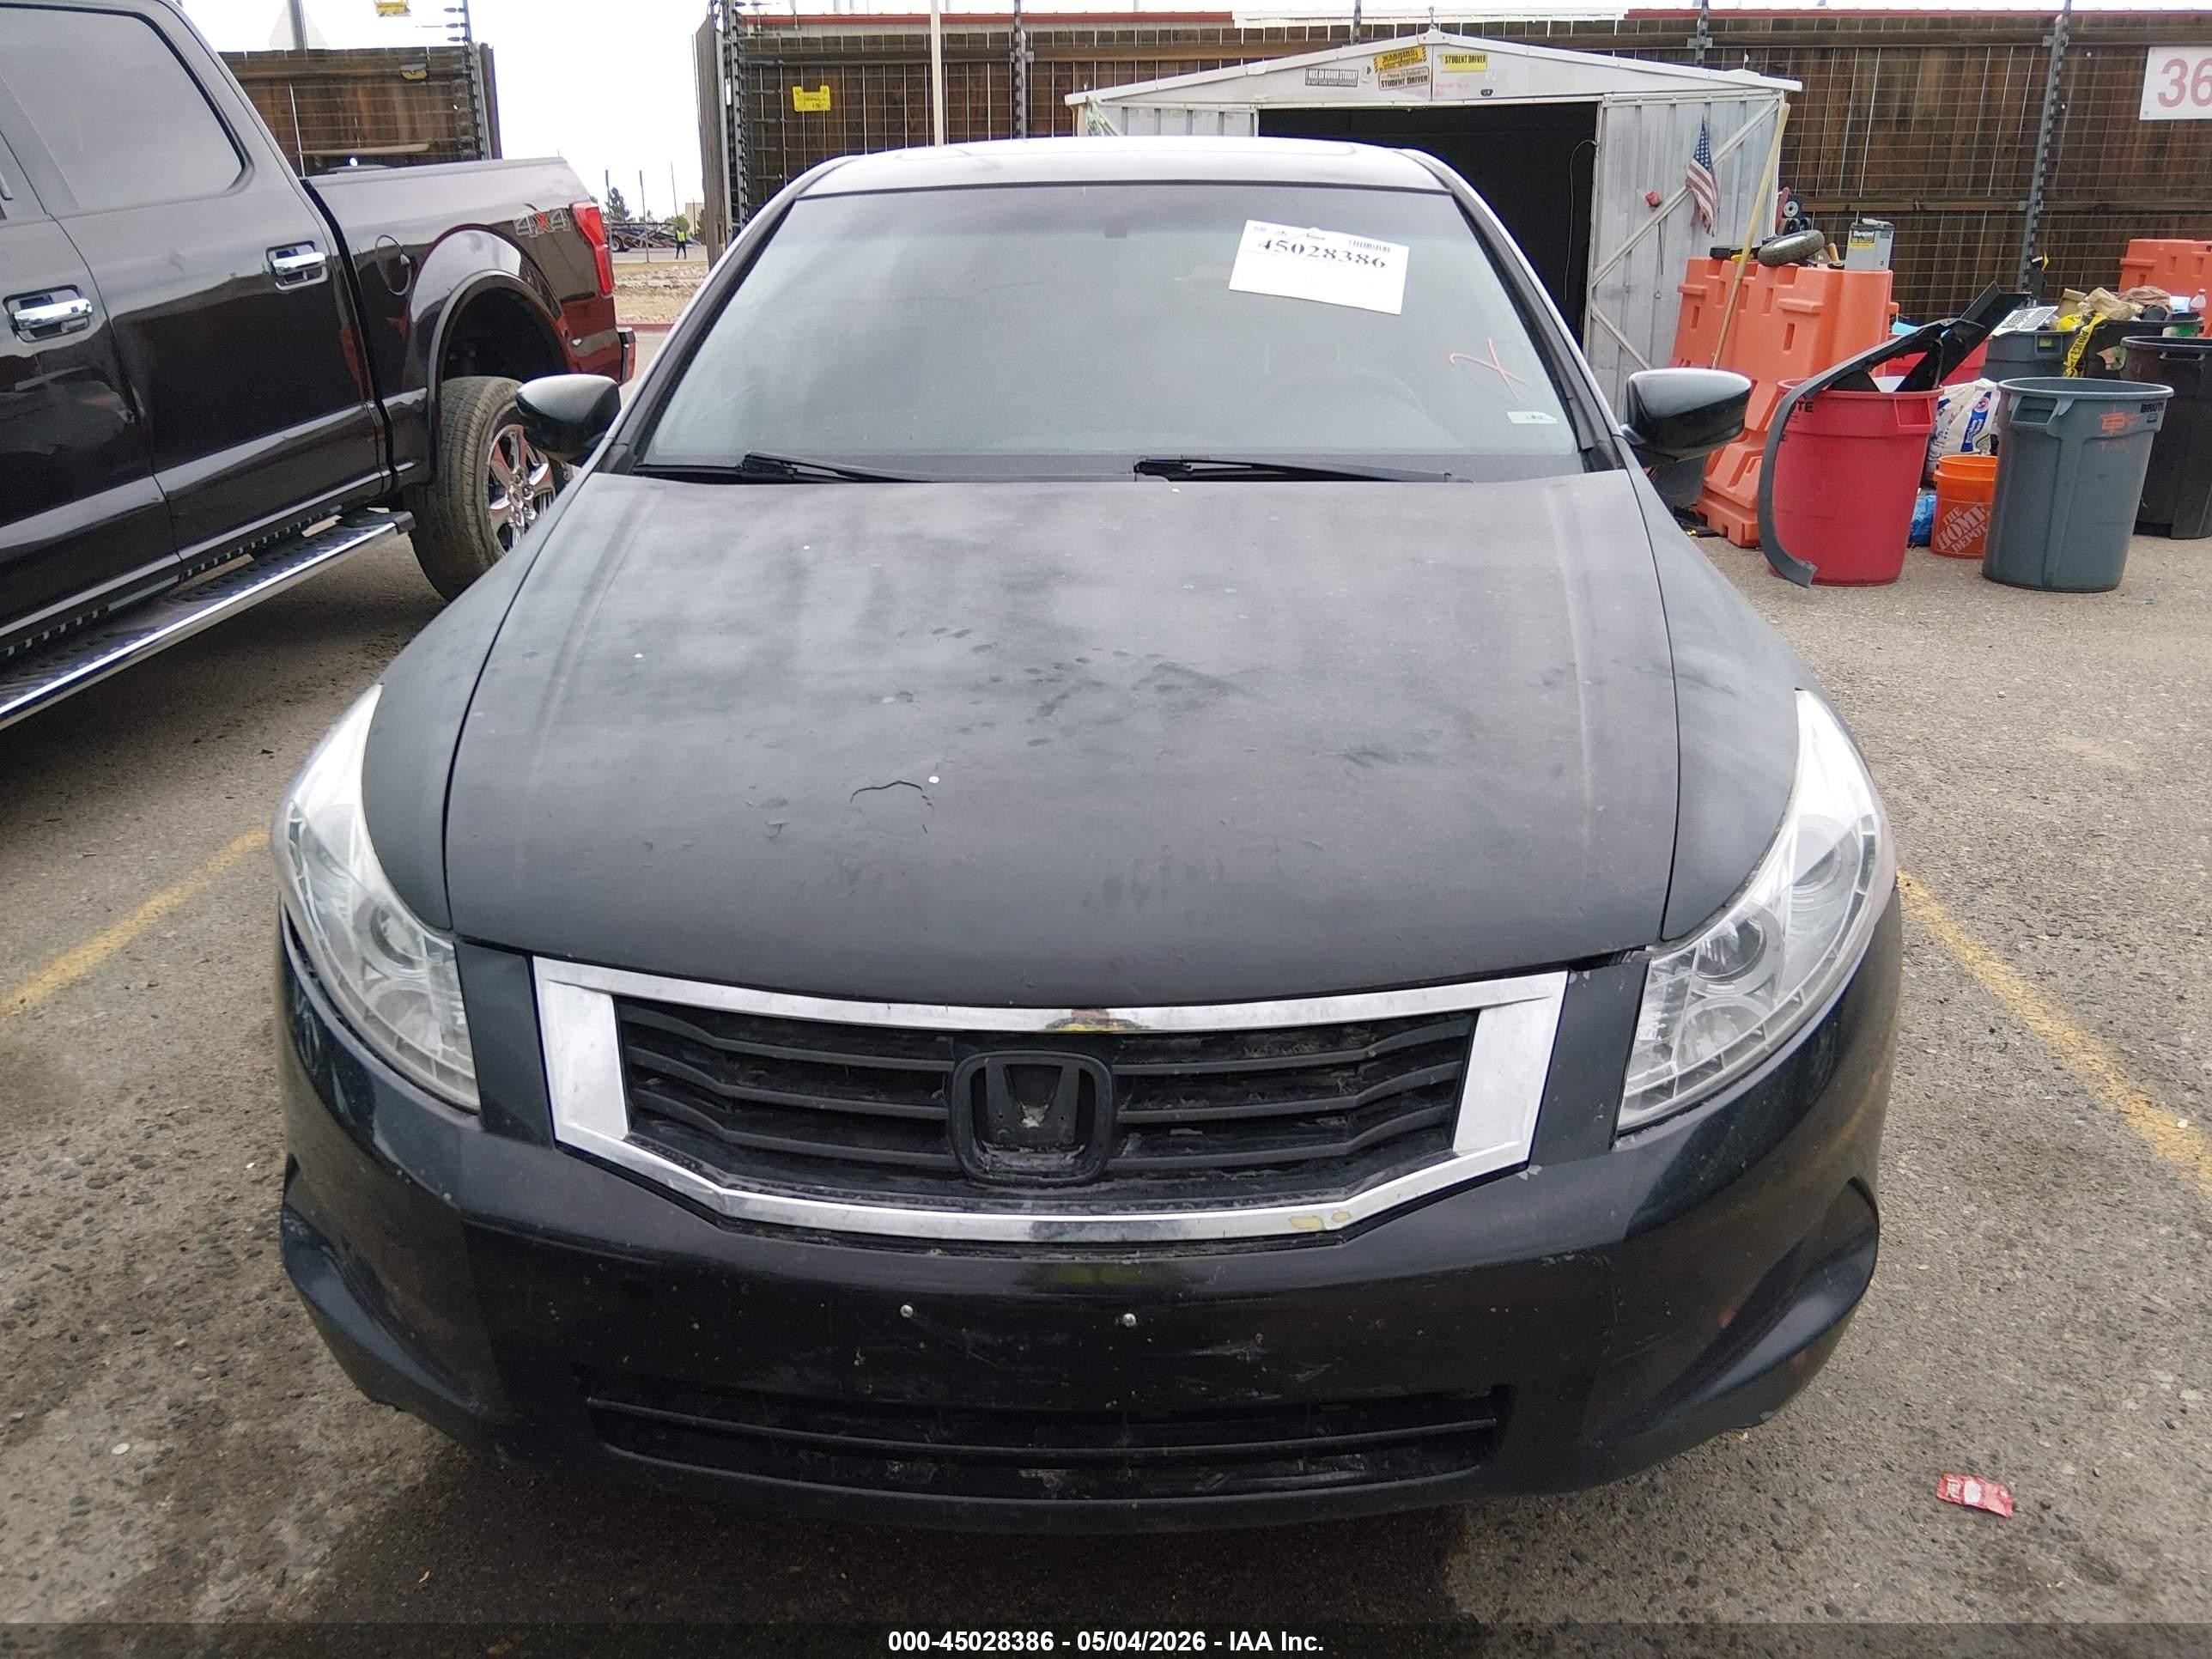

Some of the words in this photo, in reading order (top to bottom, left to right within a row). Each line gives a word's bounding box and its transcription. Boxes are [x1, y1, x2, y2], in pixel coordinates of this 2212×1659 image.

[1445, 55, 1468, 64] STUDENT
[1468, 55, 1486, 64] DRIVER
[1381, 78, 1405, 88] STUDENT
[1407, 75, 1428, 85] DRIVER
[2158, 58, 2212, 107] 36
[1258, 240, 1386, 269] 45028386
[1936, 504, 1990, 550] HOME
[1942, 507, 1963, 526] THE
